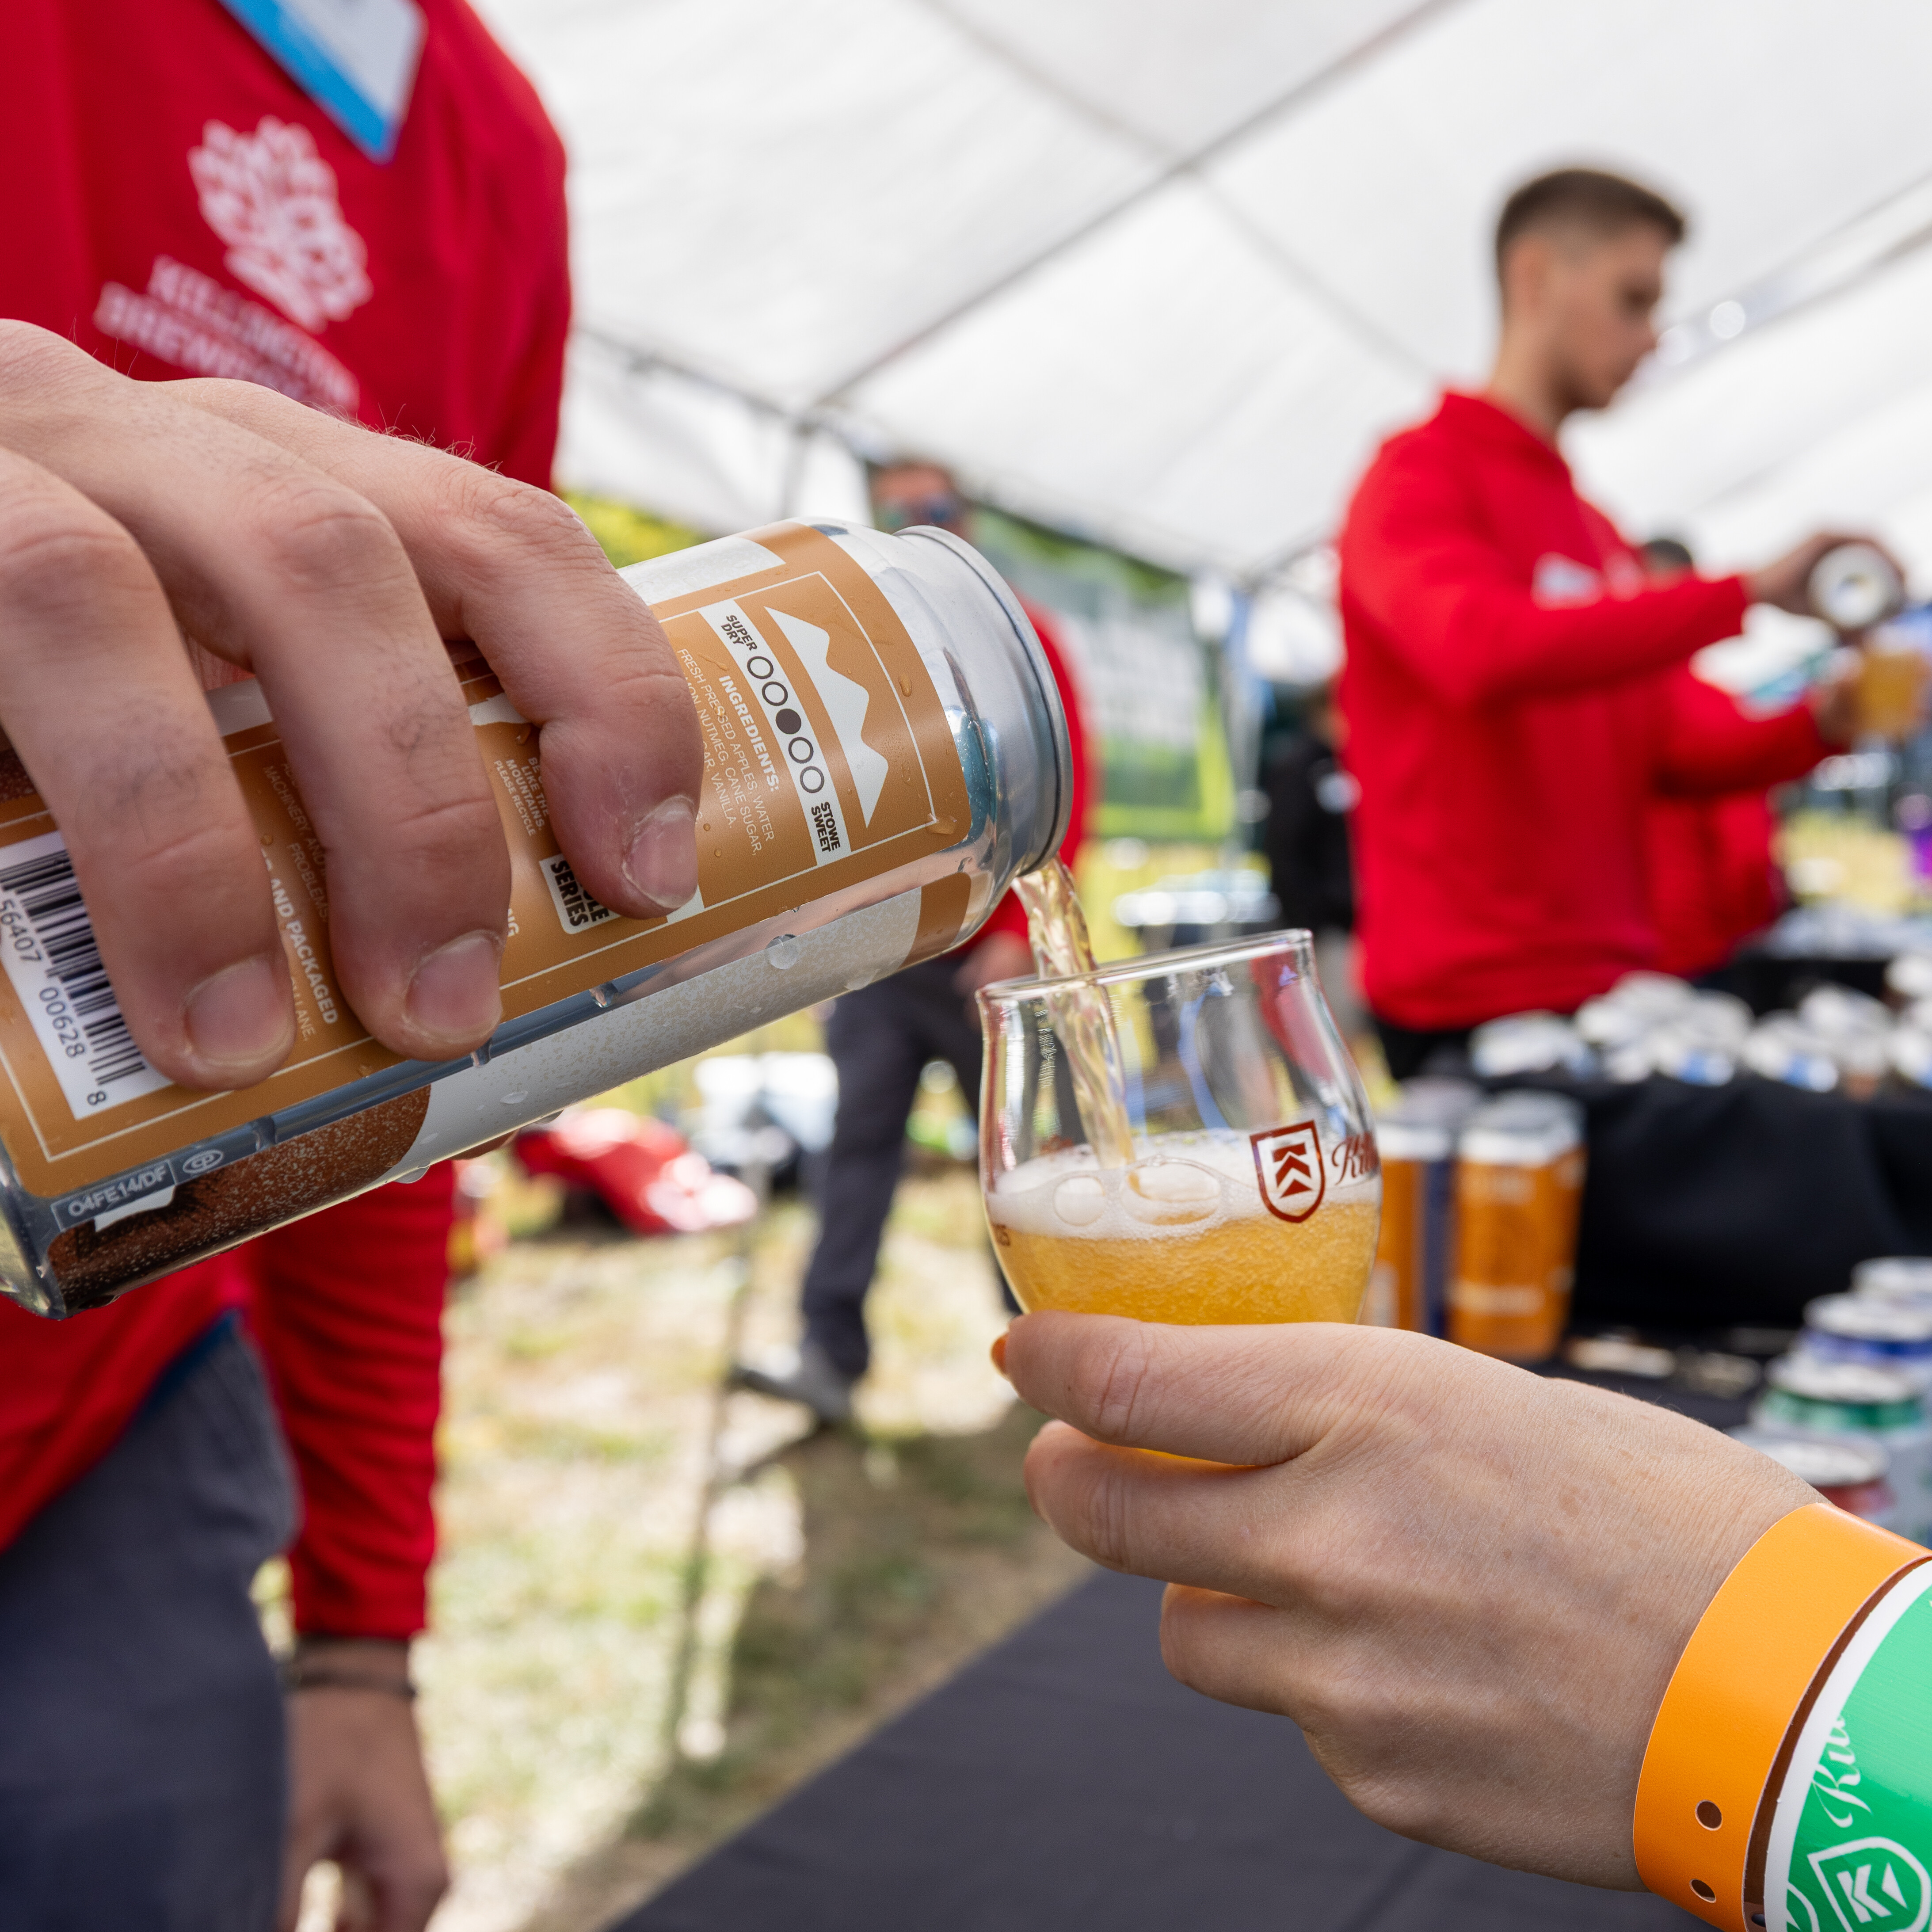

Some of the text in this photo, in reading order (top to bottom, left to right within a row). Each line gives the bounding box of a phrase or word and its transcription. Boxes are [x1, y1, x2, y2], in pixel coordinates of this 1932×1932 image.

[720, 623, 744, 647] DRY
[726, 614, 757, 651] SUPER
[528, 757, 541, 774] BE
[677, 648, 706, 687] FRESH
[701, 685, 736, 743] PRESSED
[731, 743, 758, 795] APPLES,
[753, 795, 775, 842] WATER
[719, 675, 779, 792] INGREDIENTS:
[493, 760, 537, 837] PLEASE RECYCLE
[506, 759, 545, 831] MOUNTAINS.
[521, 766, 539, 793] LIKE
[535, 792, 550, 817] THE
[697, 709, 763, 857] NUTMEG, CANE SUGAR,
[711, 772, 732, 829] VANILLA.
[811, 806, 831, 852] SWEET
[820, 801, 841, 849] STOWE
[550, 860, 589, 926] SERIES
[287, 920, 339, 1024] PACKAGED
[38, 987, 86, 1058] 00628
[87, 1090, 107, 1106] 8
